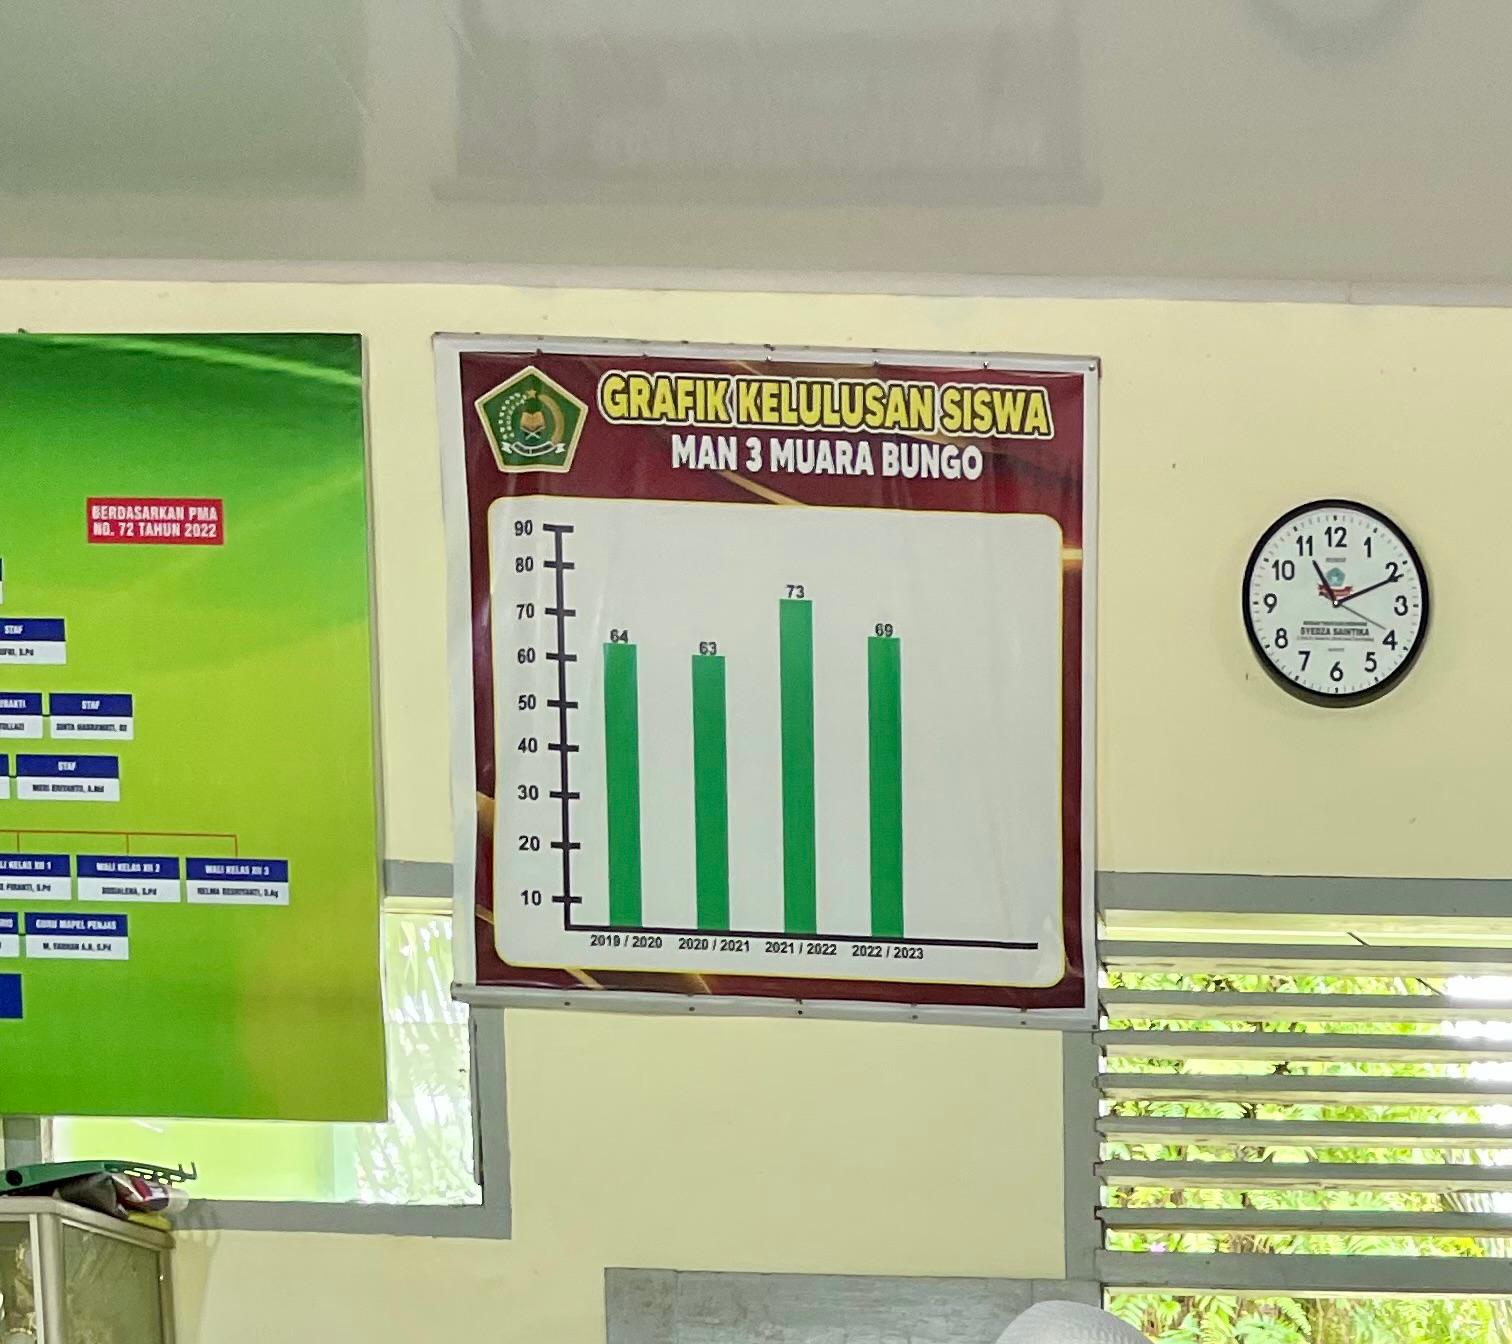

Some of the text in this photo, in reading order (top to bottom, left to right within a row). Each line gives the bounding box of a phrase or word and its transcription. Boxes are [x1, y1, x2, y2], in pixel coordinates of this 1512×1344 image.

[602, 374, 1050, 435] GRAFIK KELULUSAN SISWA
[672, 434, 984, 480] MAN 3 MUARA BUNGO
[92, 505, 217, 521] BERDASARKAN PMA
[93, 522, 216, 537] NO. 72 TAHUN 2022
[514, 520, 533, 536] 90
[1324, 526, 1347, 547] 12
[1296, 535, 1313, 556] 11
[1364, 537, 1371, 557] 1
[515, 556, 534, 572] 80
[1271, 559, 1295, 580] 10
[1385, 562, 1399, 582] 2
[786, 584, 805, 599] 73
[516, 603, 535, 619] 70
[1264, 593, 1277, 613] 9
[1394, 595, 1408, 616] 3
[610, 629, 629, 644] 64
[875, 623, 894, 638] 69
[1274, 628, 1288, 649] 8
[1382, 629, 1398, 650] 4
[516, 648, 536, 664] 60
[699, 641, 718, 656] 63
[1298, 651, 1311, 671] 7
[1364, 652, 1377, 672] 5
[1330, 661, 1343, 681] 6
[517, 694, 537, 711] 50
[517, 737, 538, 754] 40
[517, 785, 539, 802] 30
[518, 836, 541, 853] 20
[520, 890, 542, 906] 10
[590, 934, 620, 948] 2019
[632, 935, 663, 950] 2020
[678, 937, 708, 951] 2020
[719, 938, 751, 953] 2021
[765, 941, 796, 955] 2021
[806, 942, 838, 956] 2022
[852, 944, 883, 958] 2022
[894, 946, 924, 960] 2023
